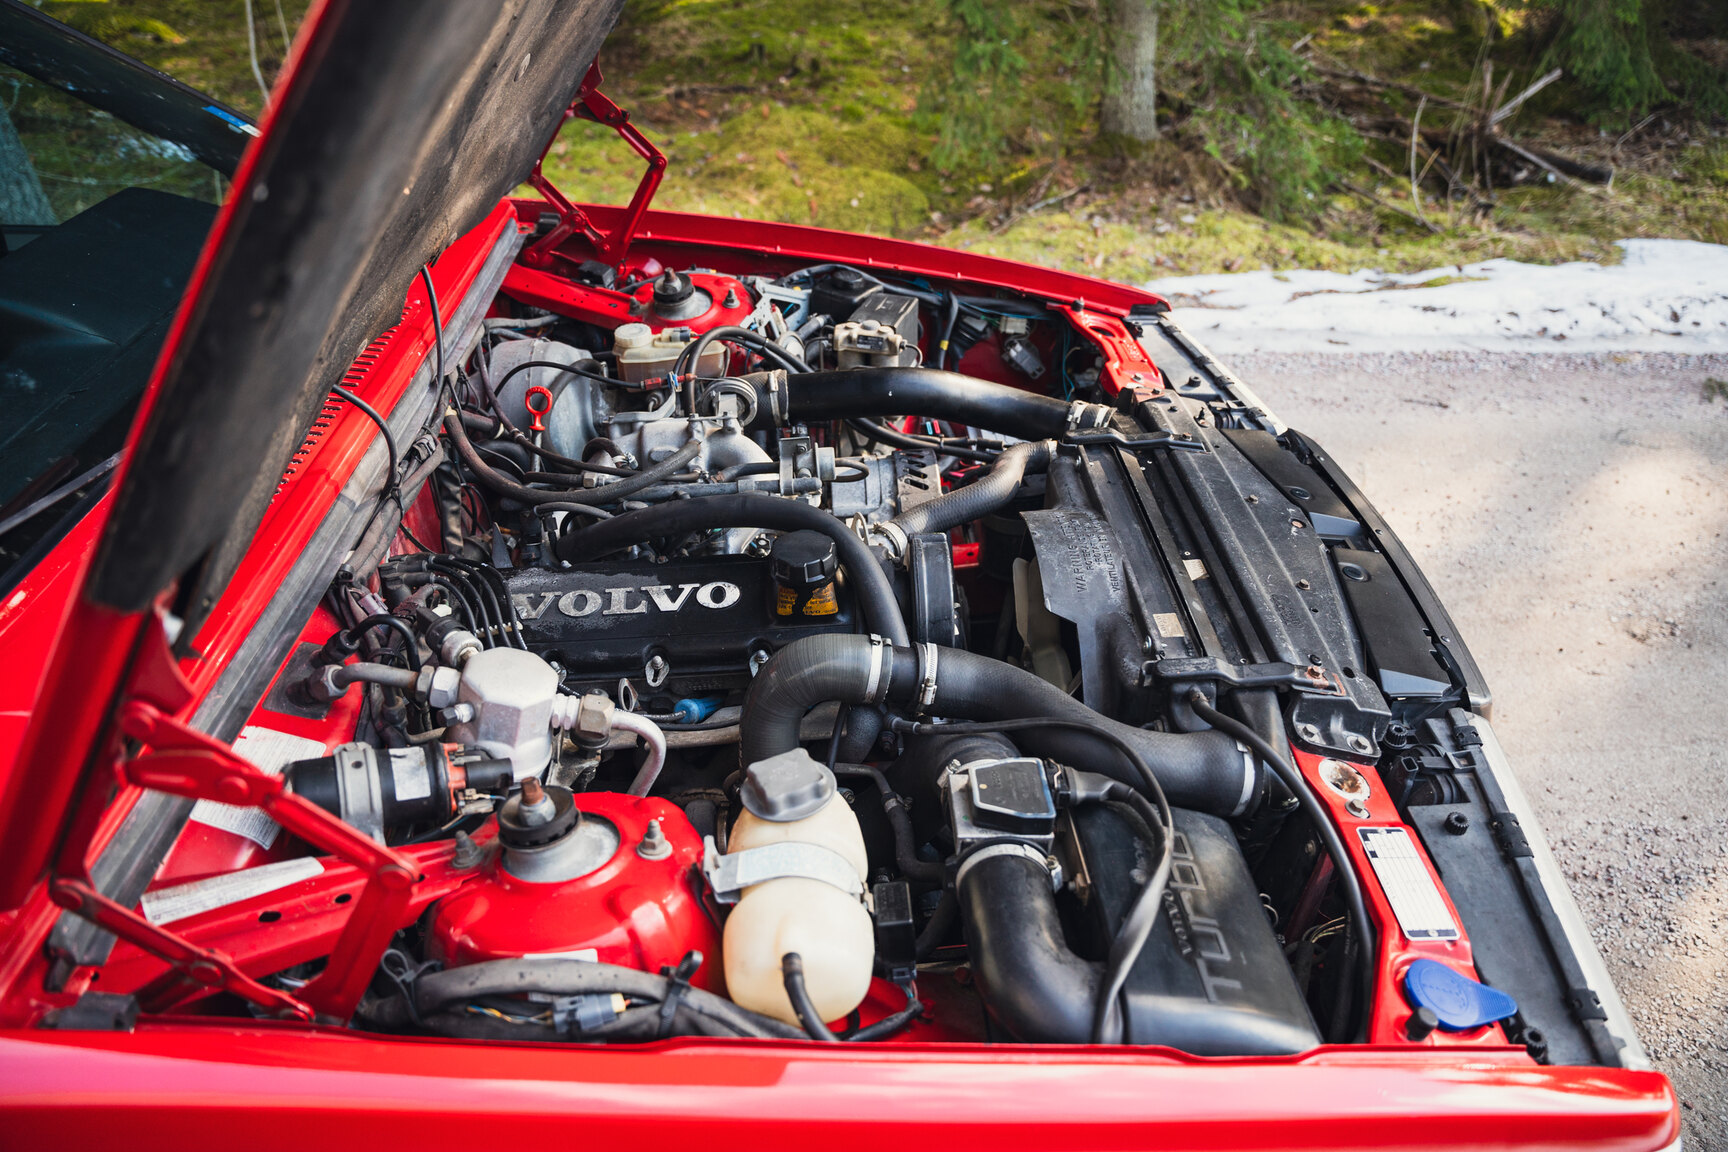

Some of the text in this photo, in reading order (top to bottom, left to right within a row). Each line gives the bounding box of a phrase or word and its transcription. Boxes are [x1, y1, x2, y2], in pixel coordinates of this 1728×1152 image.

[1067, 544, 1087, 593] WARNING
[511, 581, 742, 620] VOLVO
[1161, 889, 1193, 955] VOLVO
